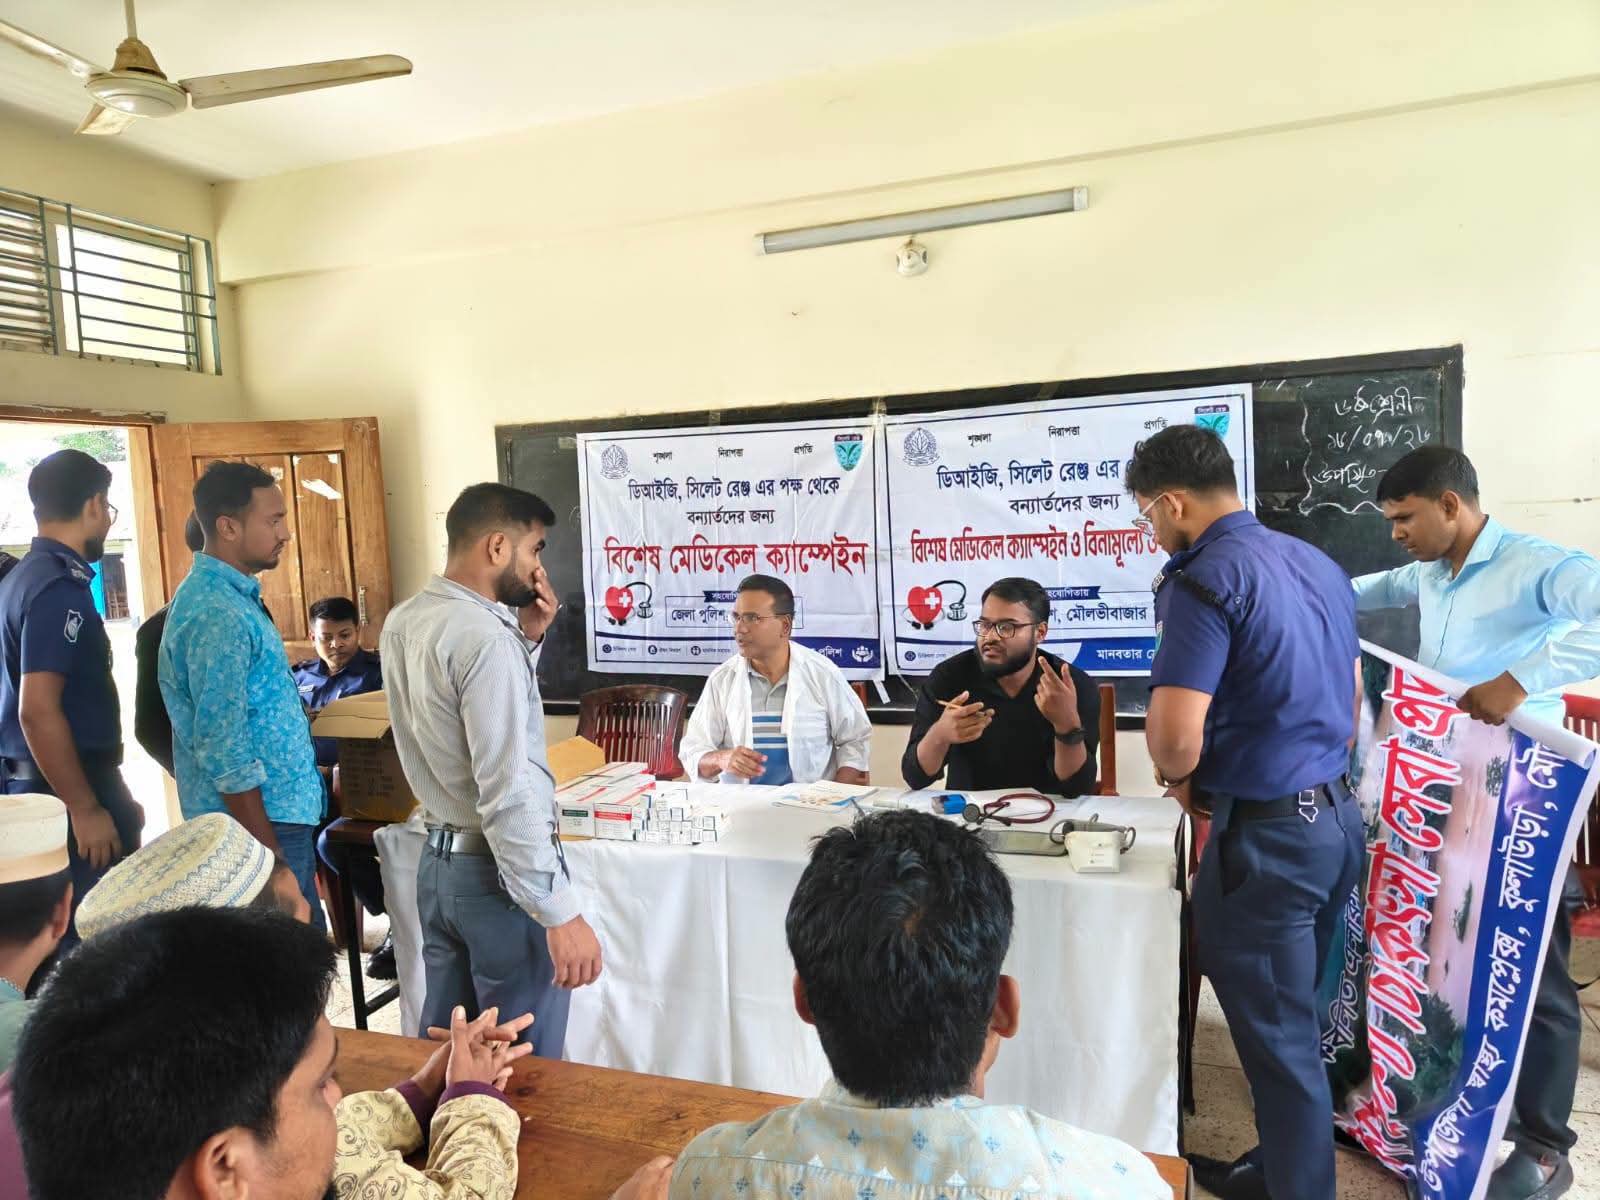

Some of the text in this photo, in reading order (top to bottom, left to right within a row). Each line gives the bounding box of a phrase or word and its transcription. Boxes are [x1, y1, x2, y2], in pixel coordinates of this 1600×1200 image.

[1143, 417, 1168, 430] প্রগতি
[628, 475, 841, 502] ডিআইজি, সিলেট রেঞ্জ এর পক্ষ থেকে
[936, 464, 1003, 491] ডিআইজি,
[1008, 459, 1053, 485] সিলেট
[1059, 460, 1089, 483] রেঞ্জ
[1095, 459, 1120, 480] এর
[686, 506, 775, 526] বন্যার্তদের জন্য
[1008, 491, 1121, 515] বন্যার্তদের জন্য
[603, 532, 869, 577] বিশেষ মেডিকেল ক্যাম্পেইন
[911, 528, 947, 563] বিশেষ
[950, 527, 1005, 562] মেডিকেল
[1007, 524, 1068, 560] ক্যাম্পেইন
[1071, 536, 1080, 557] ও
[1083, 520, 1147, 567] বিনামূল্যে
[671, 607, 695, 622] জেলা
[1066, 602, 1148, 623] মৌলভীবাজার
[1096, 648, 1143, 660] মানবতার
[1378, 736, 1463, 853] সেবা
[1498, 802, 1559, 914] কুলাউড়া,
[1485, 927, 1531, 1032] কমপ্লেক্স,
[1466, 1033, 1507, 1089] স্বাস্থ্য
[1419, 1091, 1474, 1192] উপজেলা
